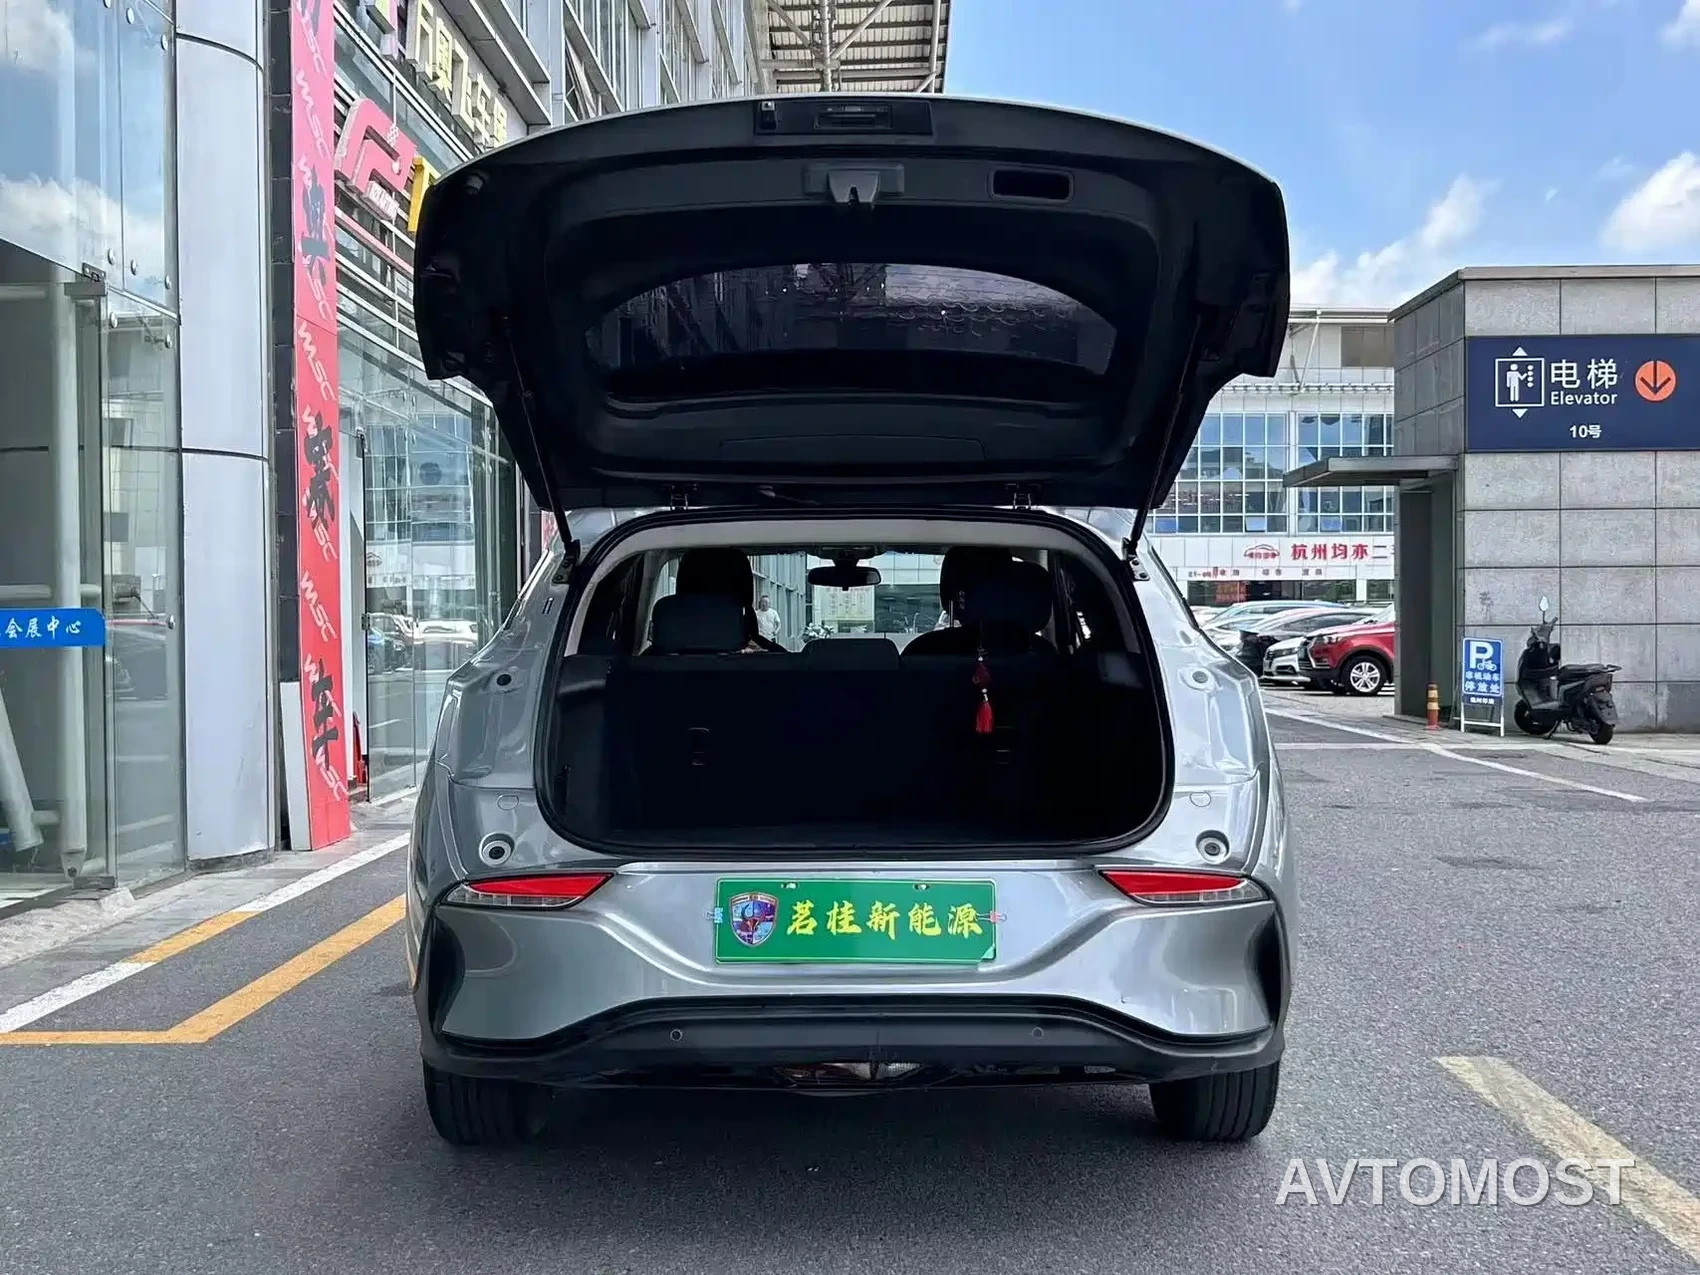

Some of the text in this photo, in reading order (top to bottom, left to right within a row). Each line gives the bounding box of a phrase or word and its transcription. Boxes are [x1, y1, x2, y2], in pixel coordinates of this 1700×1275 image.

[1550, 358, 1618, 389] 电梯
[1550, 391, 1618, 405] Elevator
[1569, 424, 1602, 439] 10号
[1291, 543, 1395, 560] 杭州均亦二
[0, 615, 82, 640] 会展中心
[1469, 641, 1494, 669] P
[786, 899, 984, 940] 茗桂新能源
